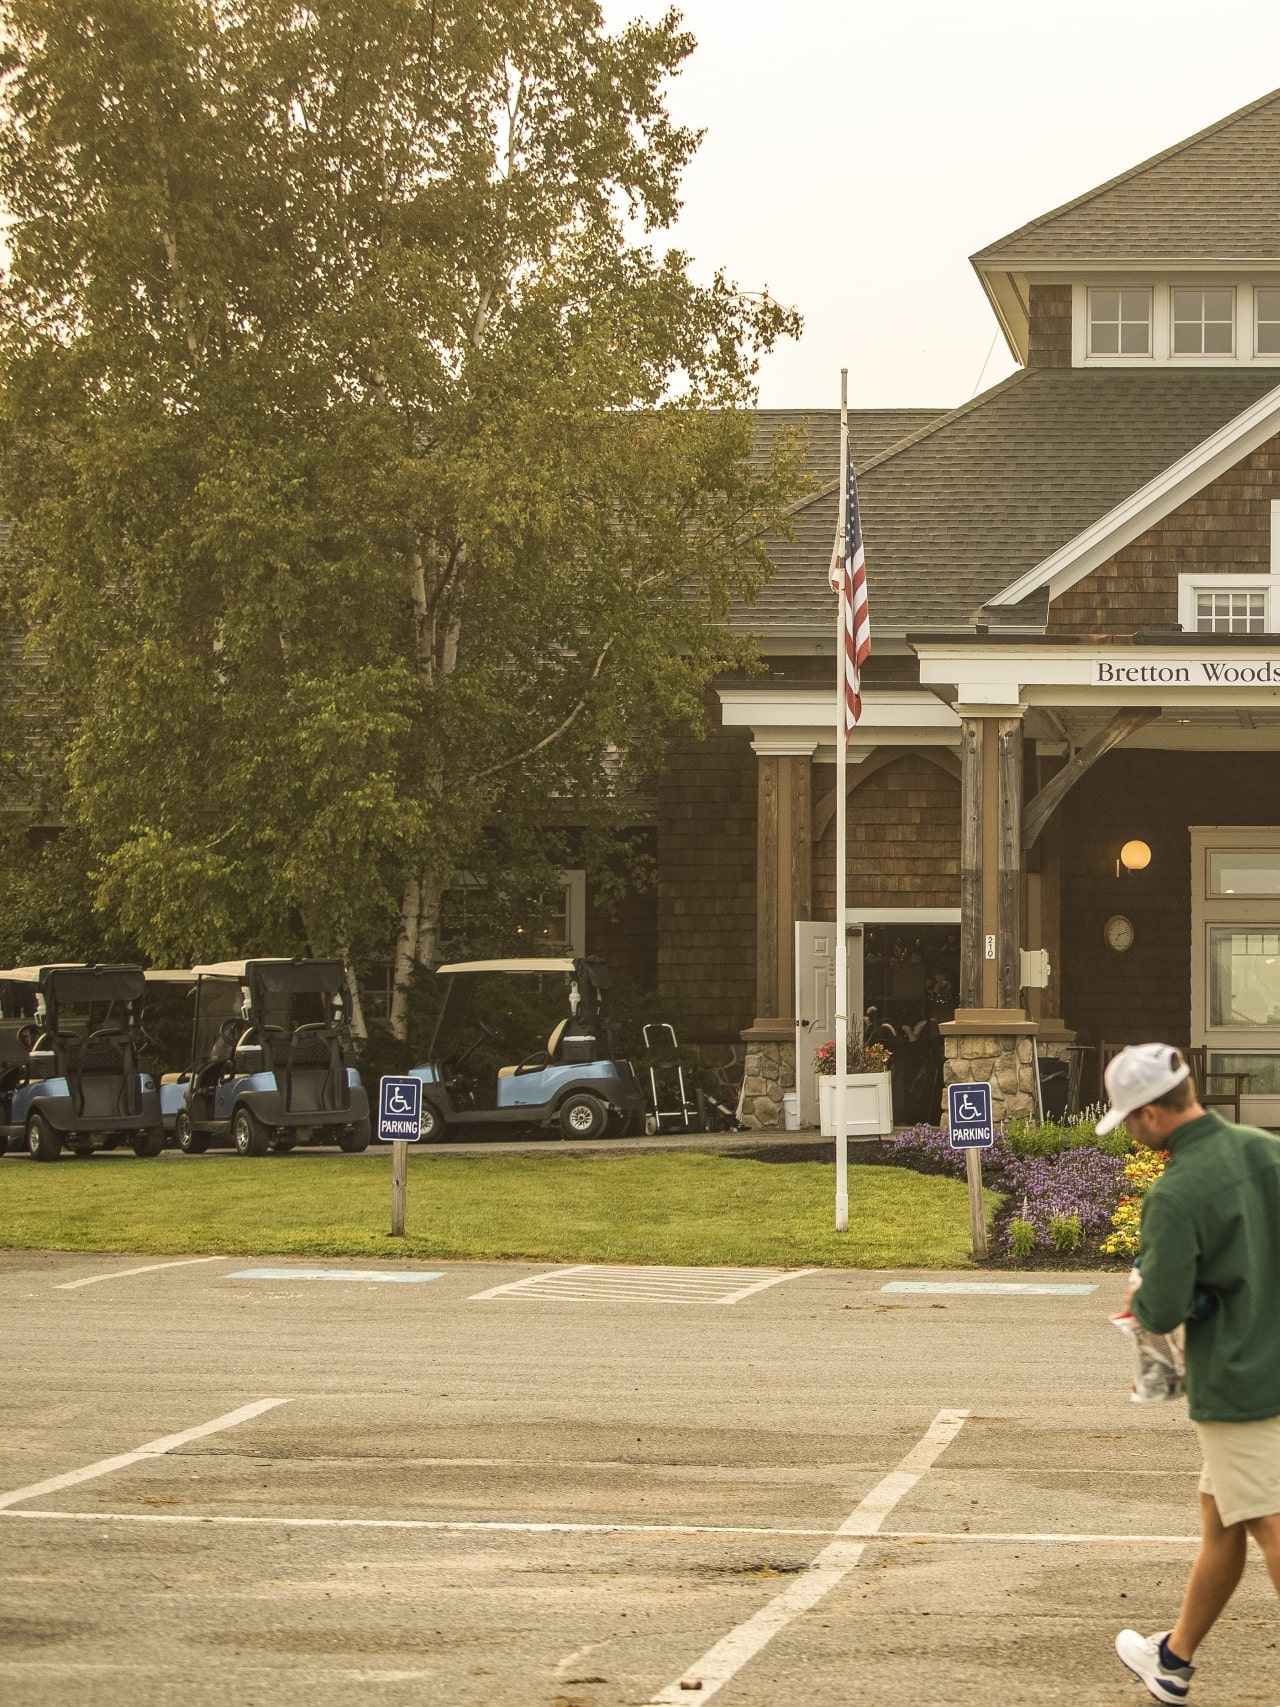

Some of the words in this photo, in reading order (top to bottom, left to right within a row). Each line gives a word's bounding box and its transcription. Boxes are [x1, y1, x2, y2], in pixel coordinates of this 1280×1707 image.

[1097, 662, 1191, 682] Bretton
[381, 1120, 418, 1134] PARKING
[952, 1127, 990, 1141] PARKING
